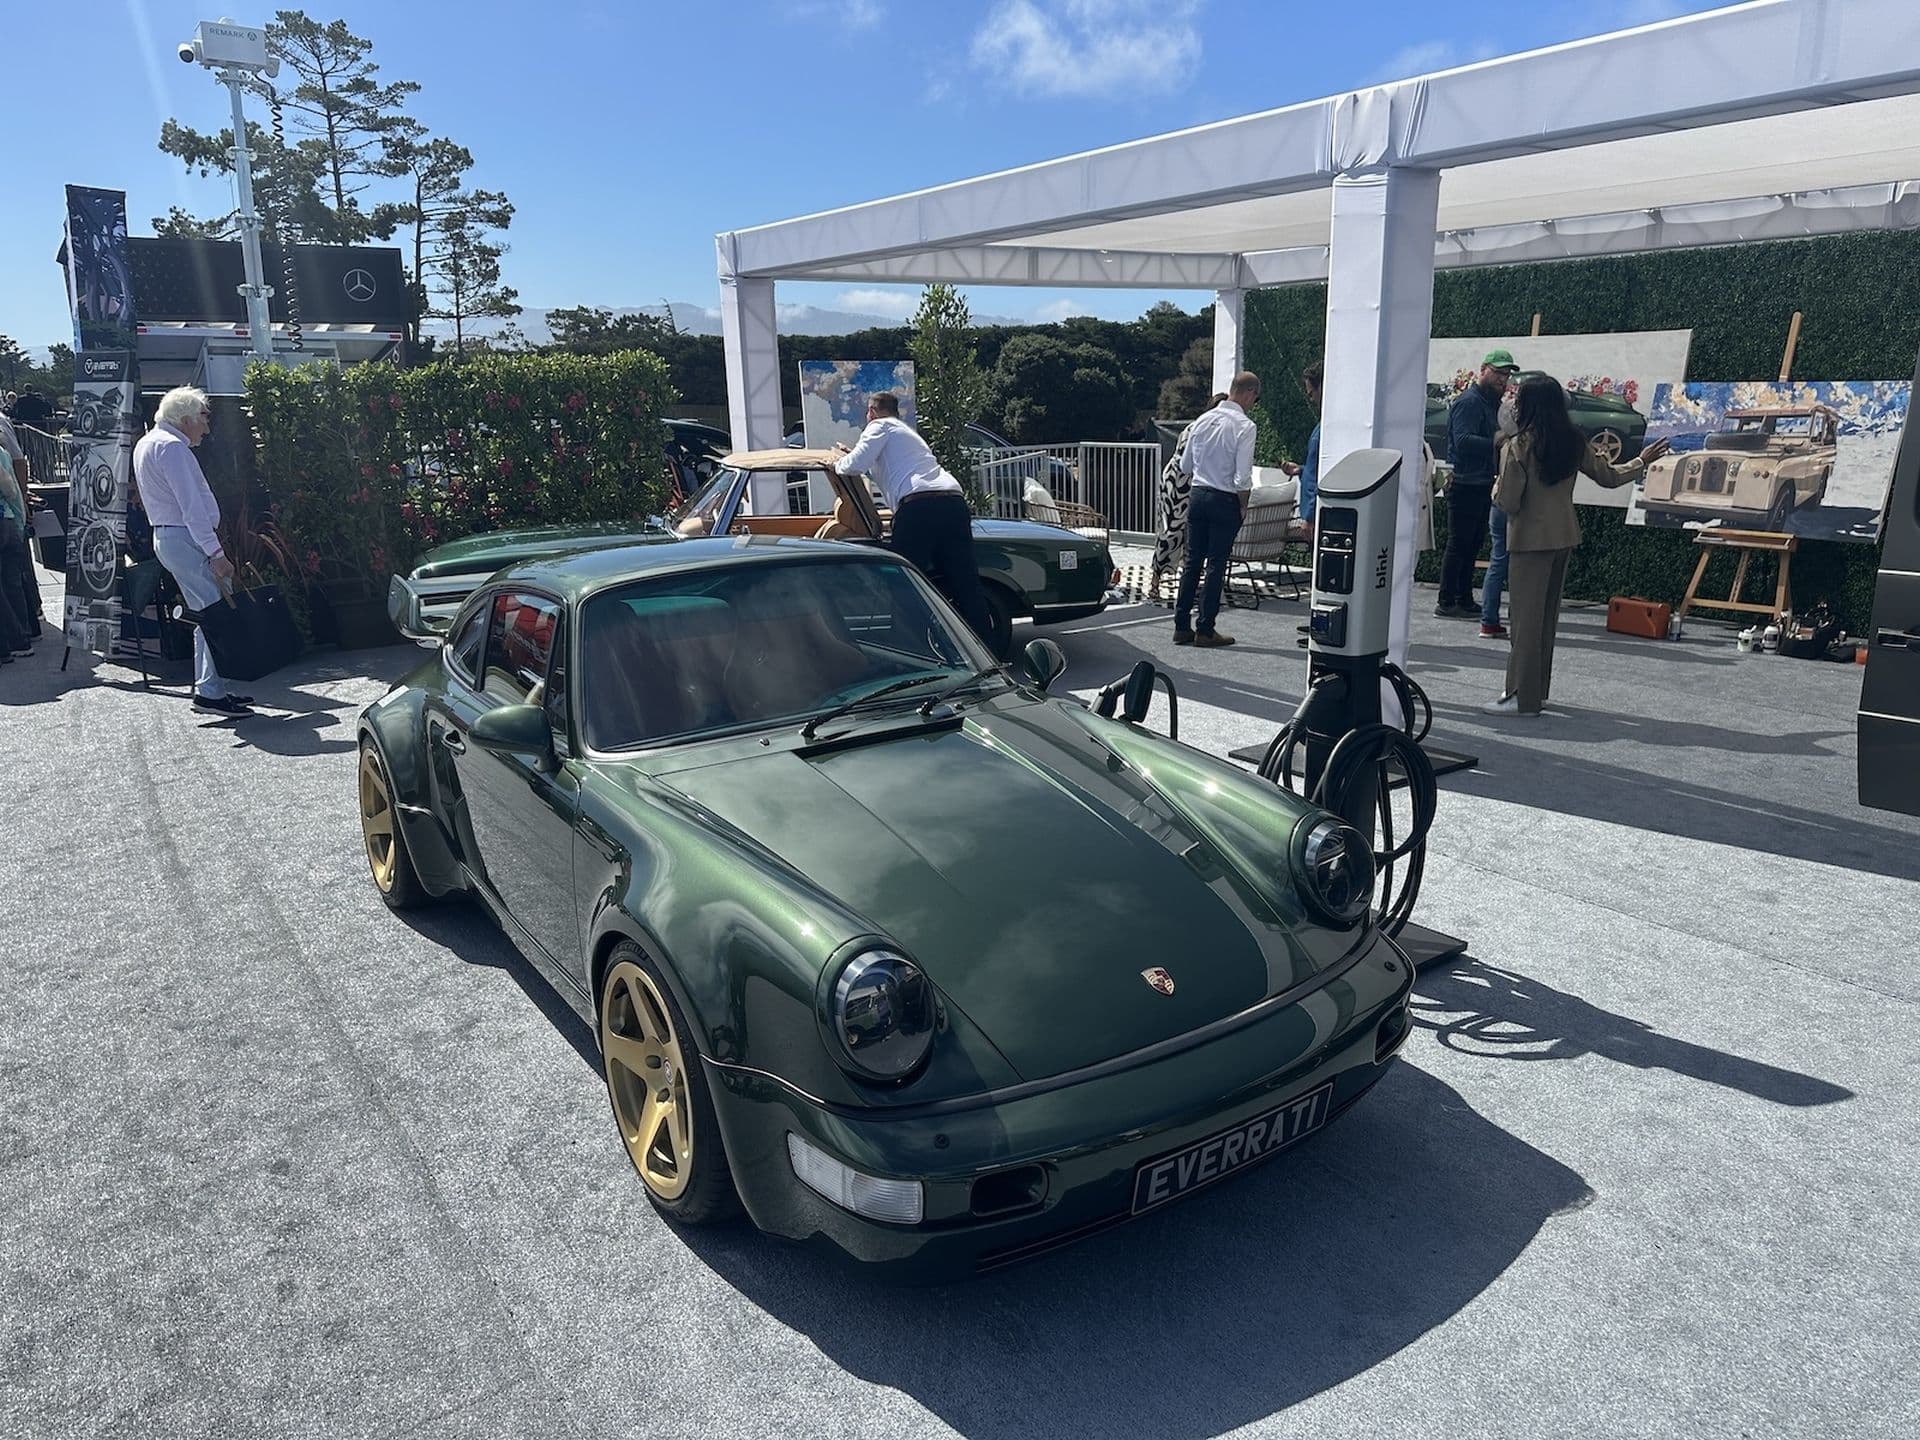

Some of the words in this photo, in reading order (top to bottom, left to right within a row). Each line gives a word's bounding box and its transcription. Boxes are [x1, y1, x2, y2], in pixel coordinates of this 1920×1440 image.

[209, 27, 245, 39] REMARK
[1375, 546, 1388, 589] blink
[1147, 1095, 1319, 1204] EVERRATI
